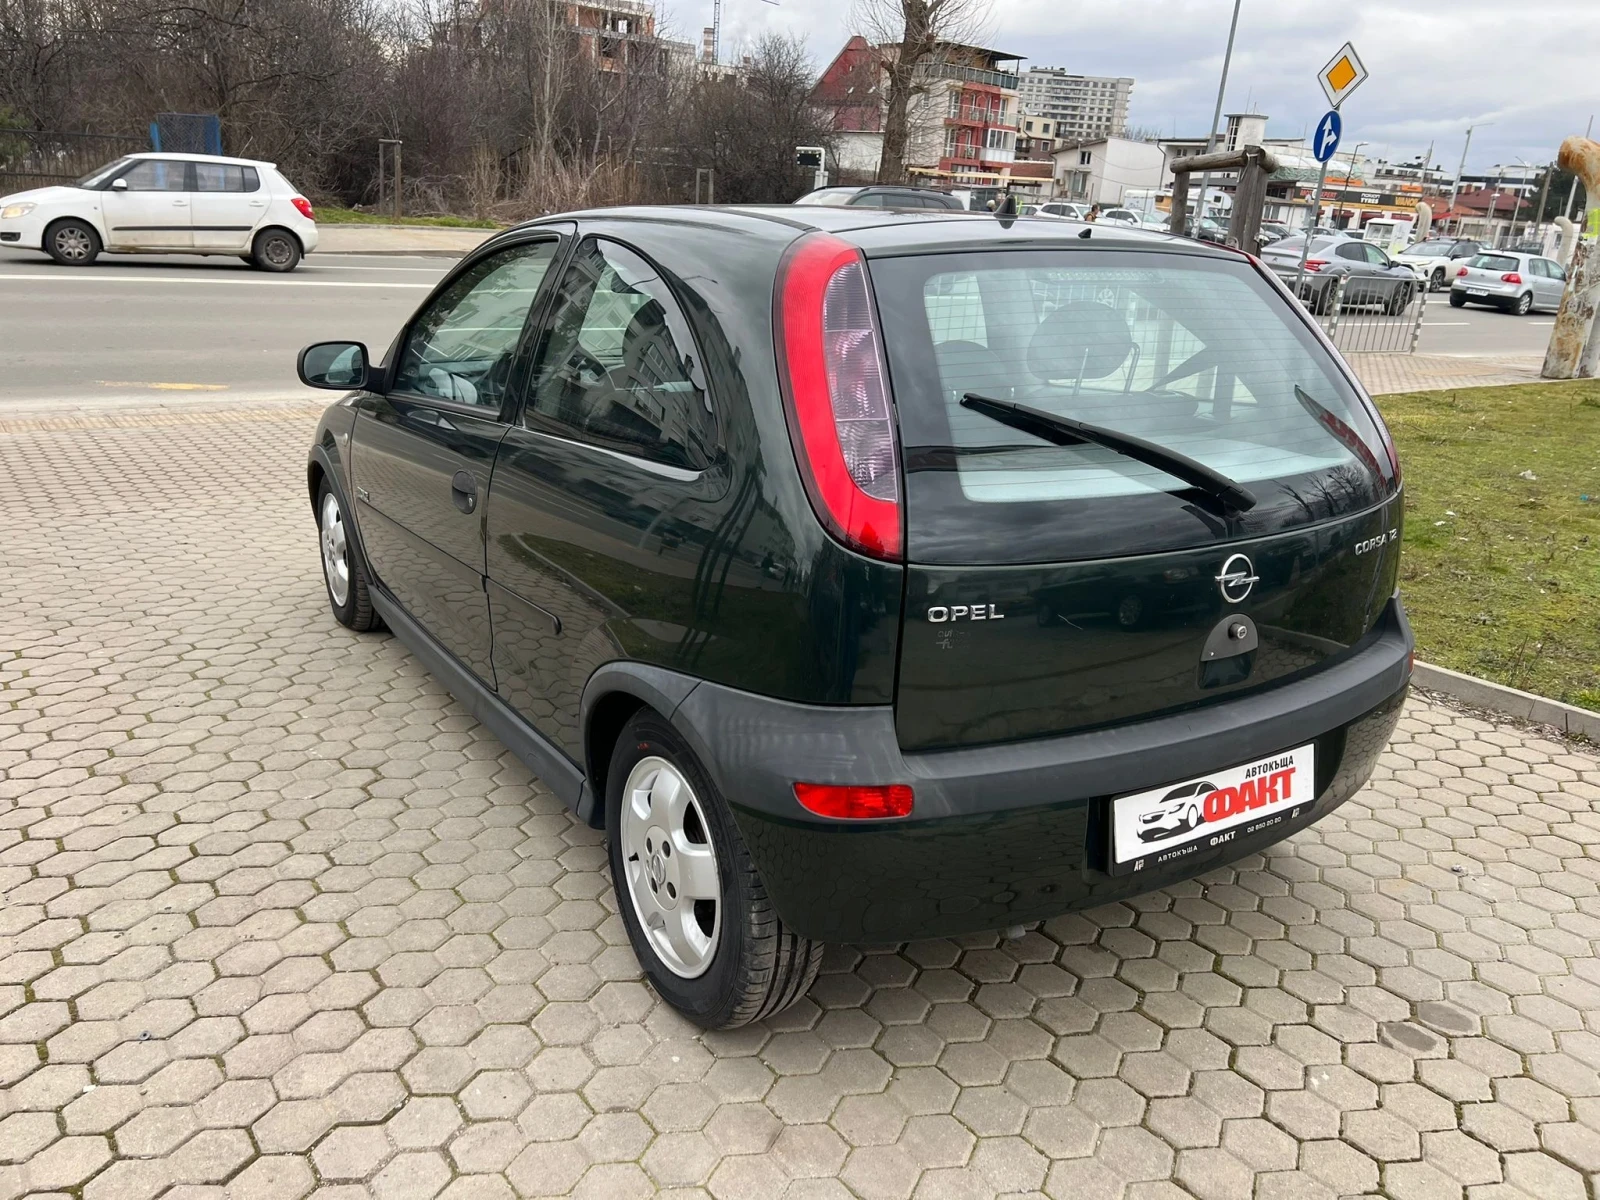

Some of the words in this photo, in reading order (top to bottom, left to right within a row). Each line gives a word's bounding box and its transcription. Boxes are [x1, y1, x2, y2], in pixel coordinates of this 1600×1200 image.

[1355, 533, 1387, 556] CORSA
[928, 603, 1005, 623] OPEL
[1245, 755, 1294, 779] АВТОКЪЩА
[1203, 767, 1296, 823] ФАКТ
[1210, 830, 1237, 846] ФАКТ
[1266, 819, 1274, 827] 20
[1274, 816, 1282, 824] 20
